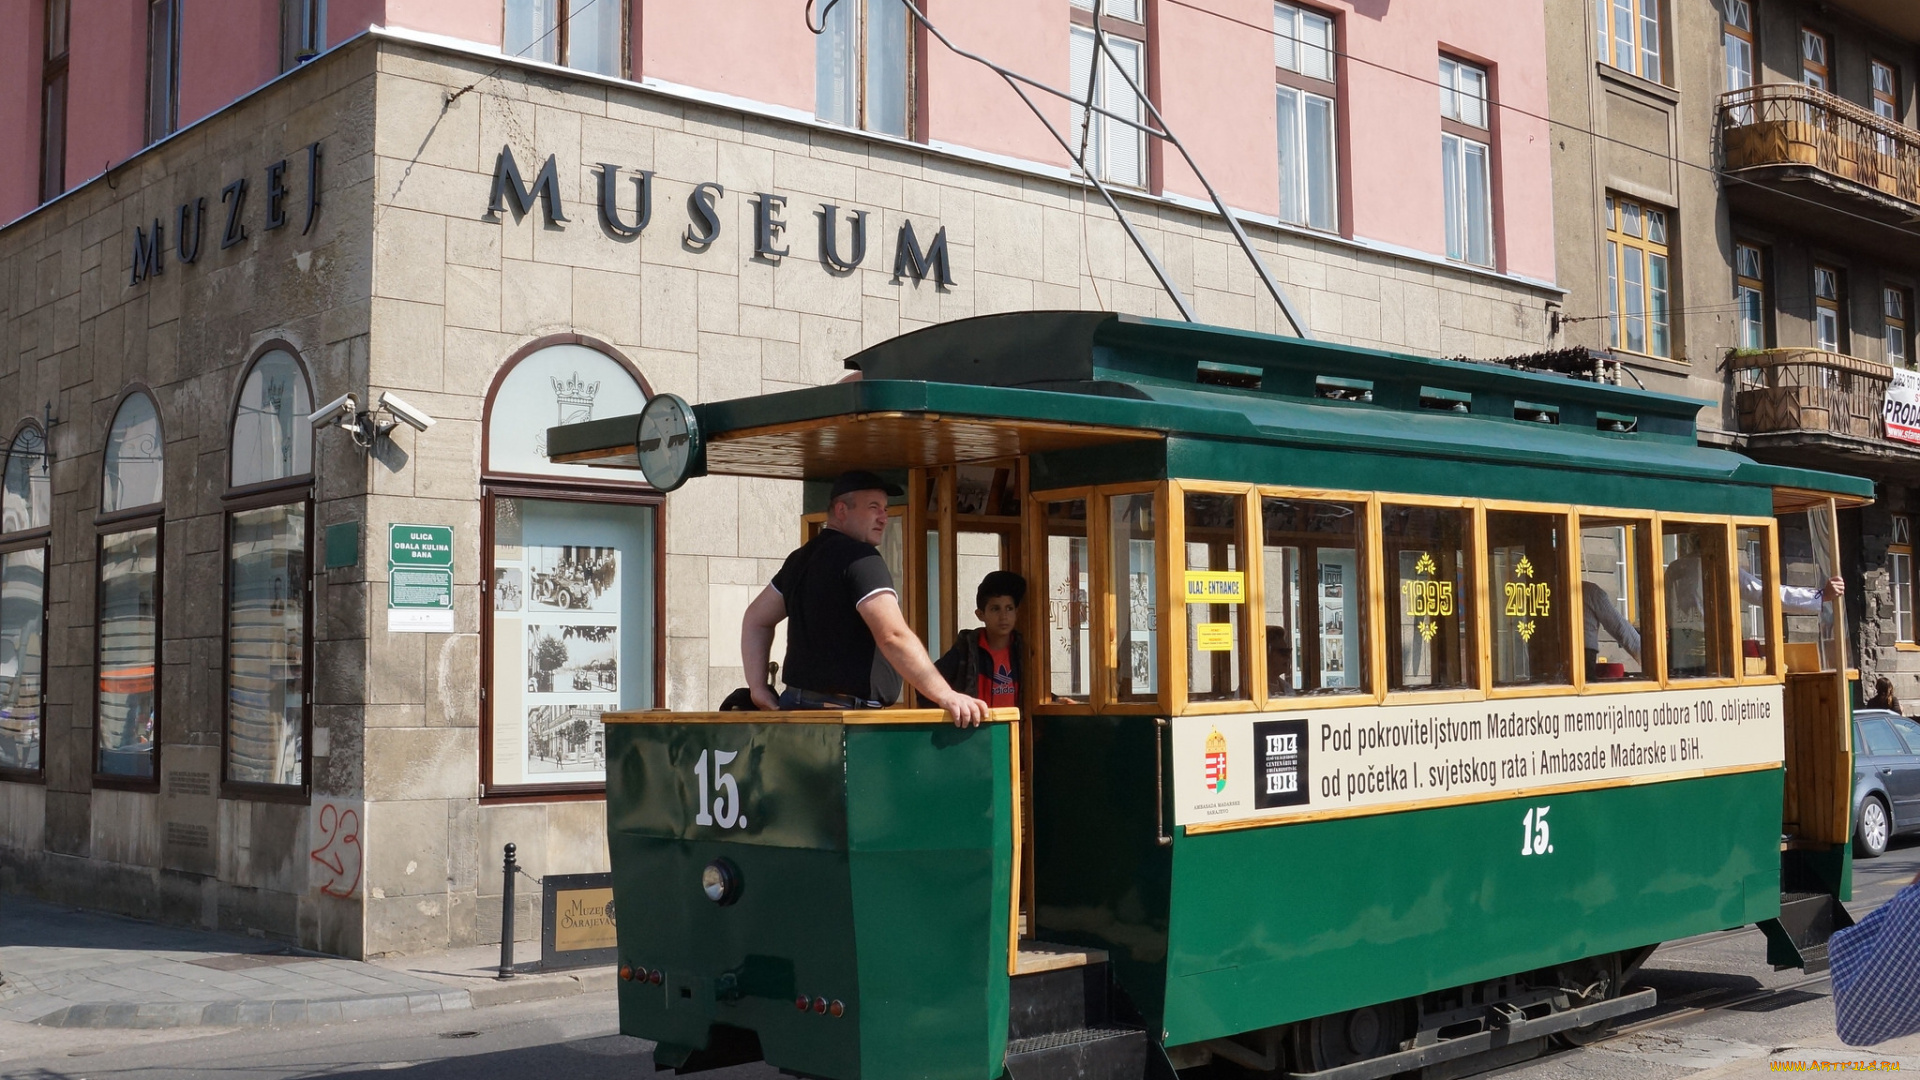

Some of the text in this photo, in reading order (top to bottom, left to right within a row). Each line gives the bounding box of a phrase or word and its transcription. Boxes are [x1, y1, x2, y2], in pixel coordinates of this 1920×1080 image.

[129, 142, 320, 287] MUZEJ
[487, 143, 958, 290] MUSEUM
[410, 533, 433, 541] ULICA
[1188, 581, 1203, 594] ULAZ
[1208, 581, 1239, 594] ENTRANCE
[1402, 580, 1453, 616] 1895
[1504, 582, 1550, 616] 2014
[1265, 733, 1298, 756] 1914
[1321, 698, 1771, 755] Pod pokroviteljstvom Mađarskog memorijalnog odbora 100. obljetnice
[694, 748, 747, 829] 15.
[1265, 771, 1298, 794] 1918
[1321, 737, 1703, 802] od početka I. svjetskog rata i Ambasade Mađarske u BiH.
[1521, 805, 1554, 856] 15.
